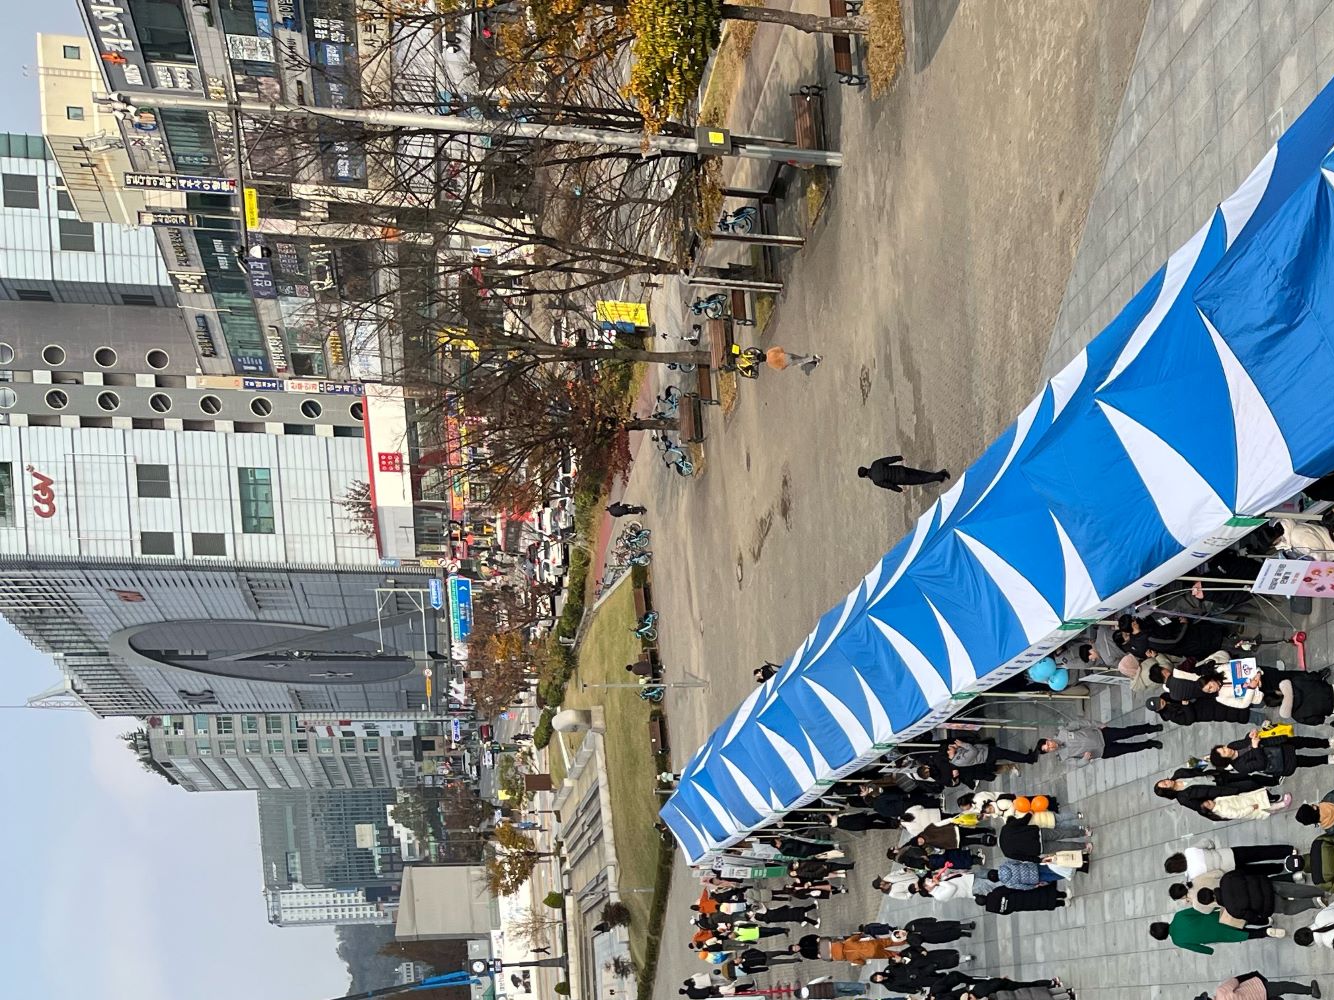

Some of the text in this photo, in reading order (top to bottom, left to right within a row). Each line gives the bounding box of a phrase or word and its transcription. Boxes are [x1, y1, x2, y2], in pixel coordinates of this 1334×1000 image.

[90, 0, 134, 51] 킴스치
[247, 261, 272, 287] 참내과
[33, 470, 56, 518] CGV
